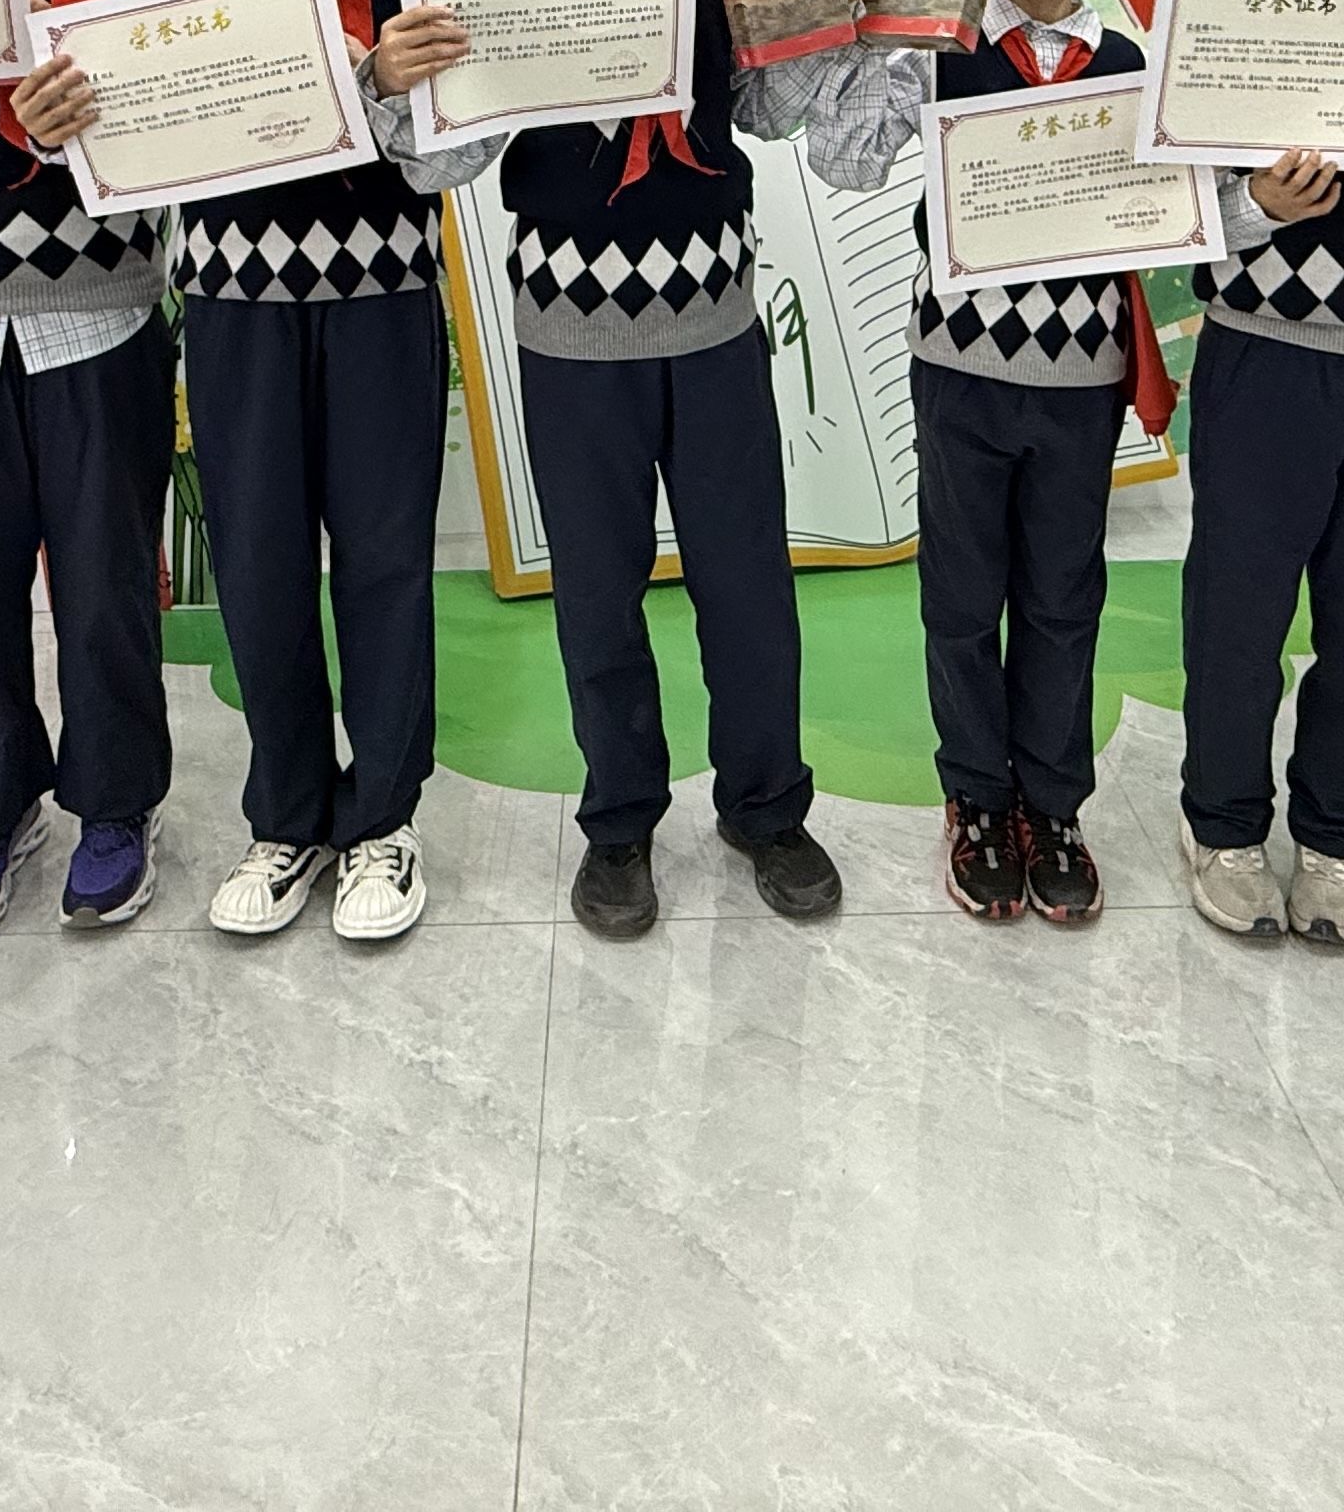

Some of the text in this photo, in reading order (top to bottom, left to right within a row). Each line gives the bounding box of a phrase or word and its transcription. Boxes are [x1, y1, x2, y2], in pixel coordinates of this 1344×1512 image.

[128, 5, 233, 51] 荣誉证书
[1017, 105, 1115, 142] 荣誉证书
